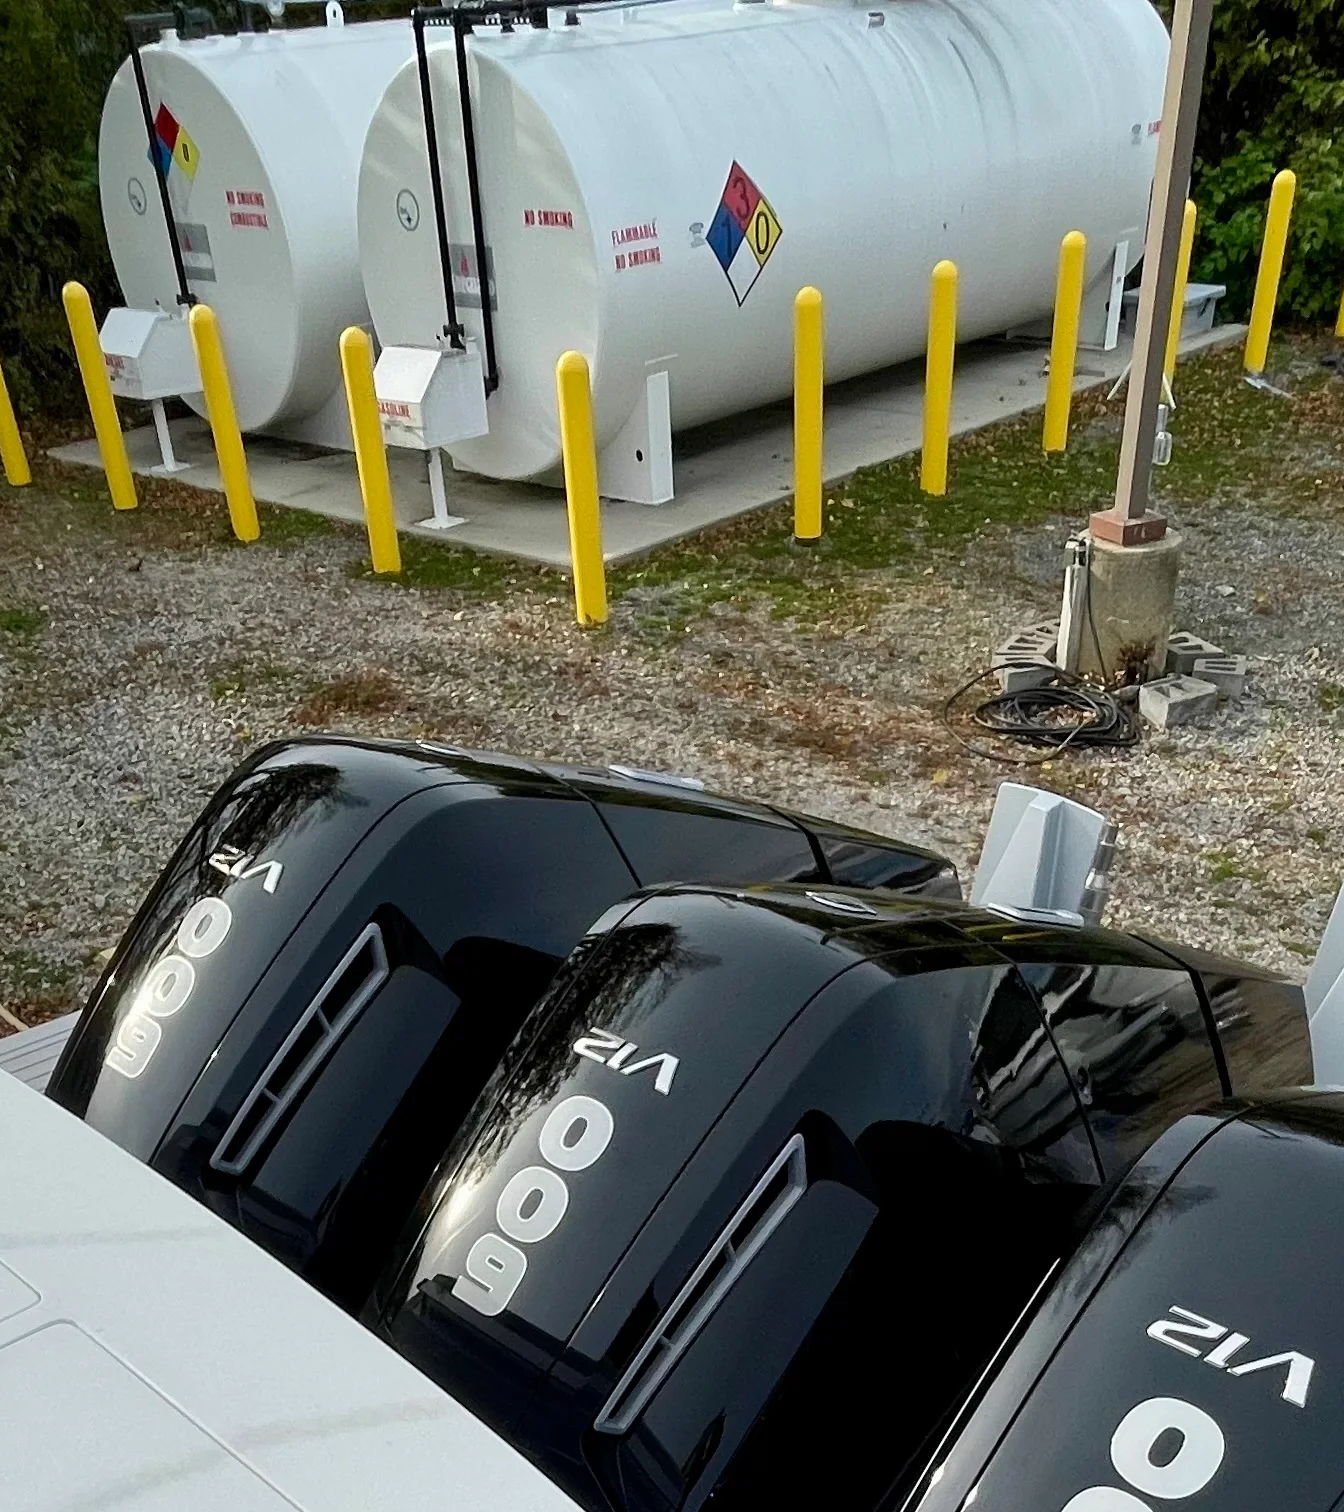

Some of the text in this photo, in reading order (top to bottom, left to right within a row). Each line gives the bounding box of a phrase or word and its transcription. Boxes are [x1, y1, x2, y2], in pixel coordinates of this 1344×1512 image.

[182, 143, 190, 162] 0
[225, 190, 264, 208] NO SMOKING
[524, 210, 573, 229] NO SMOKING
[733, 176, 751, 220] 3
[611, 219, 658, 246] FLAMMABLE
[722, 215, 732, 257] 1
[755, 211, 770, 254] 0
[615, 246, 661, 270] NO SMOKING
[208, 843, 286, 894] V12
[106, 896, 233, 1080] 600
[572, 1026, 681, 1096] V12
[450, 1094, 615, 1318] 600
[1146, 1305, 1317, 1409] V12
